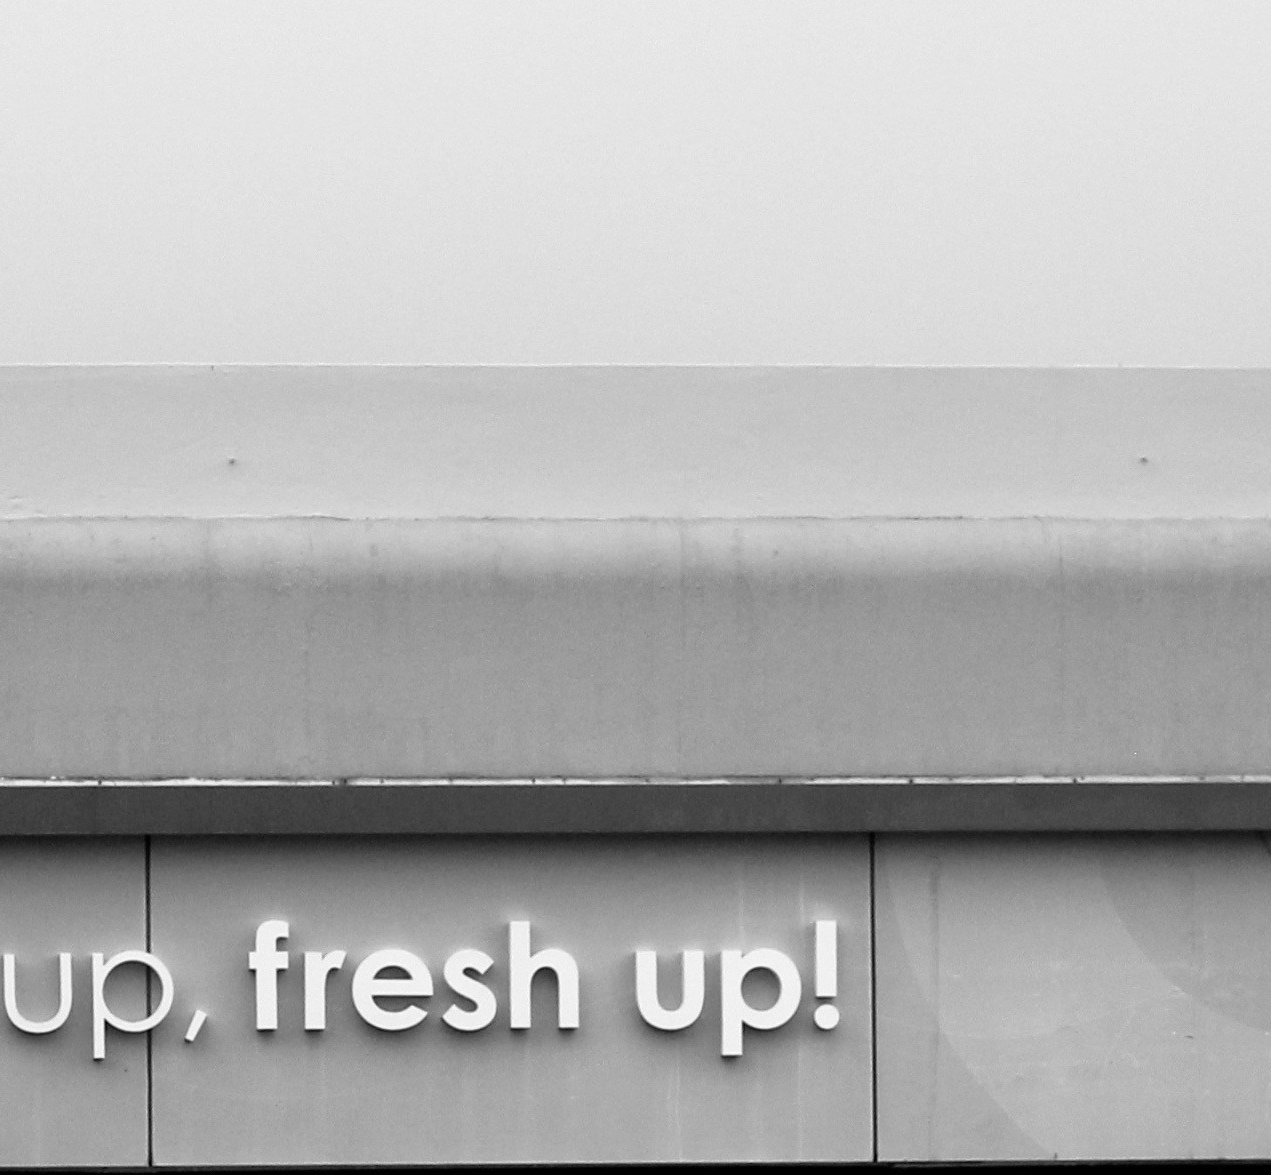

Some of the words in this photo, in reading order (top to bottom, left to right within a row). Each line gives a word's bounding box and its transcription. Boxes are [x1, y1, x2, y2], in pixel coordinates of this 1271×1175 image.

[2, 940, 210, 1059] up,
[248, 914, 580, 1031] fresh
[634, 913, 840, 1056] up!
